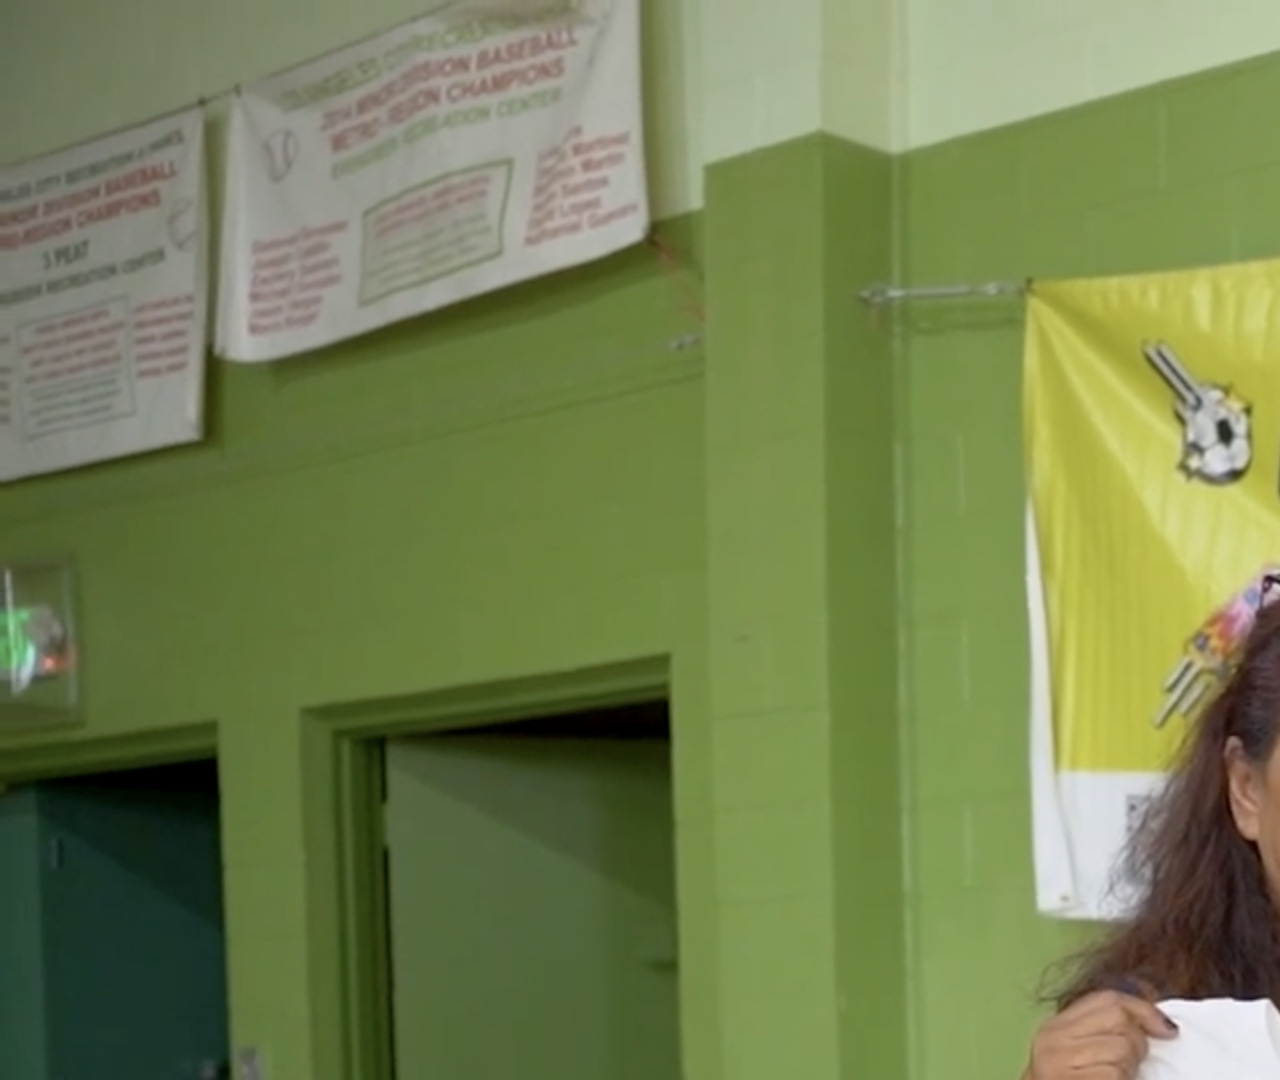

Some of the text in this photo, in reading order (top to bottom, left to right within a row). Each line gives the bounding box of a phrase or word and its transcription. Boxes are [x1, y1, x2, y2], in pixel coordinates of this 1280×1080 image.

[474, 27, 578, 70] BASEBALL
[446, 56, 565, 101] CHAMPIONS
[105, 160, 177, 197] BASEBALL
[77, 188, 161, 229] CHAMPIONS
